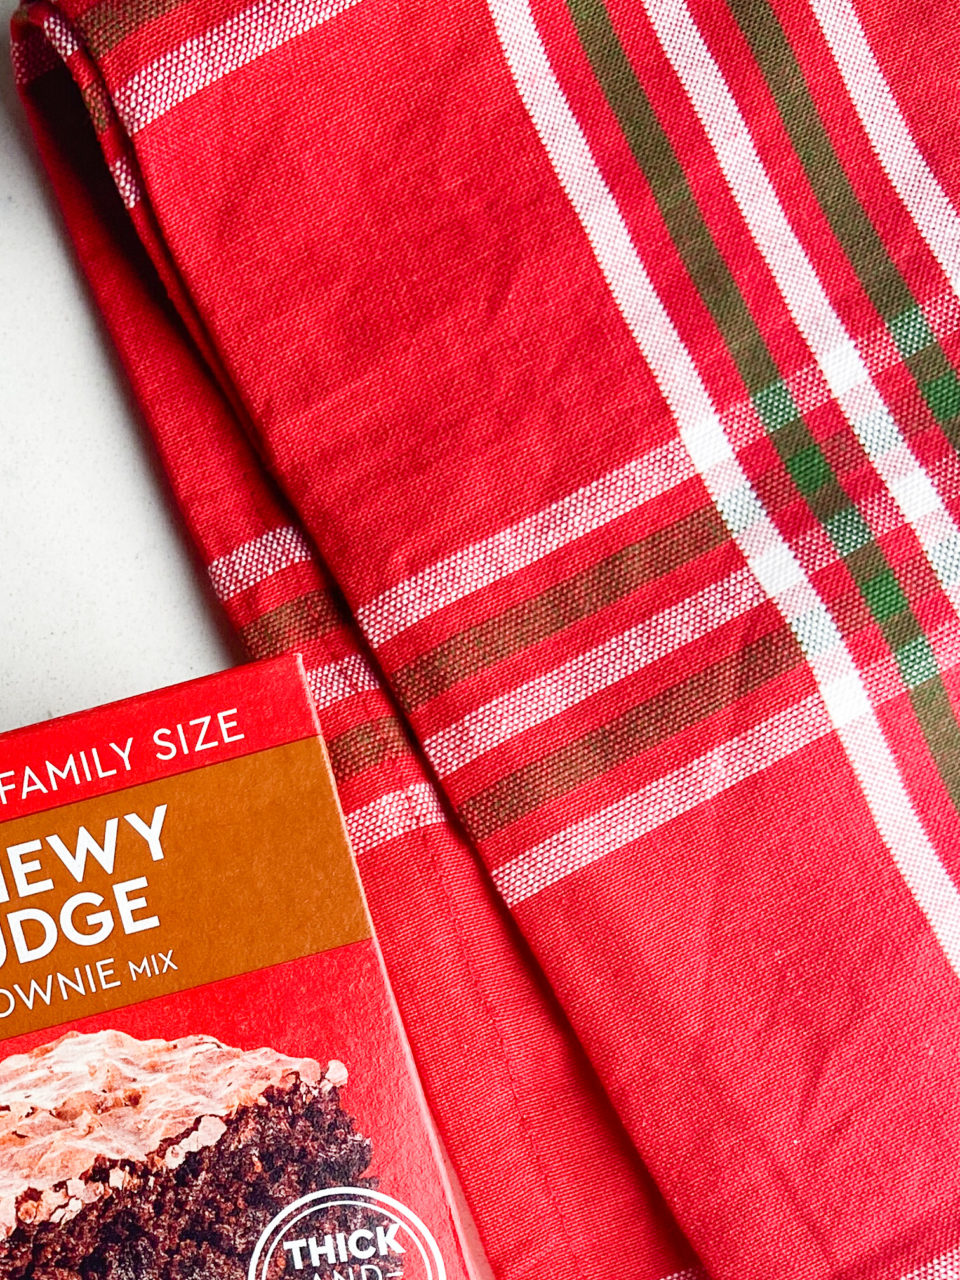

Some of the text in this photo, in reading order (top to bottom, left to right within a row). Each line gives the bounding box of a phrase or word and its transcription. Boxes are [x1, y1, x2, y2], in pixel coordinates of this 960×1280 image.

[153, 708, 244, 760] SIZE
[128, 949, 178, 981] MIX
[283, 1223, 406, 1270] THICK
